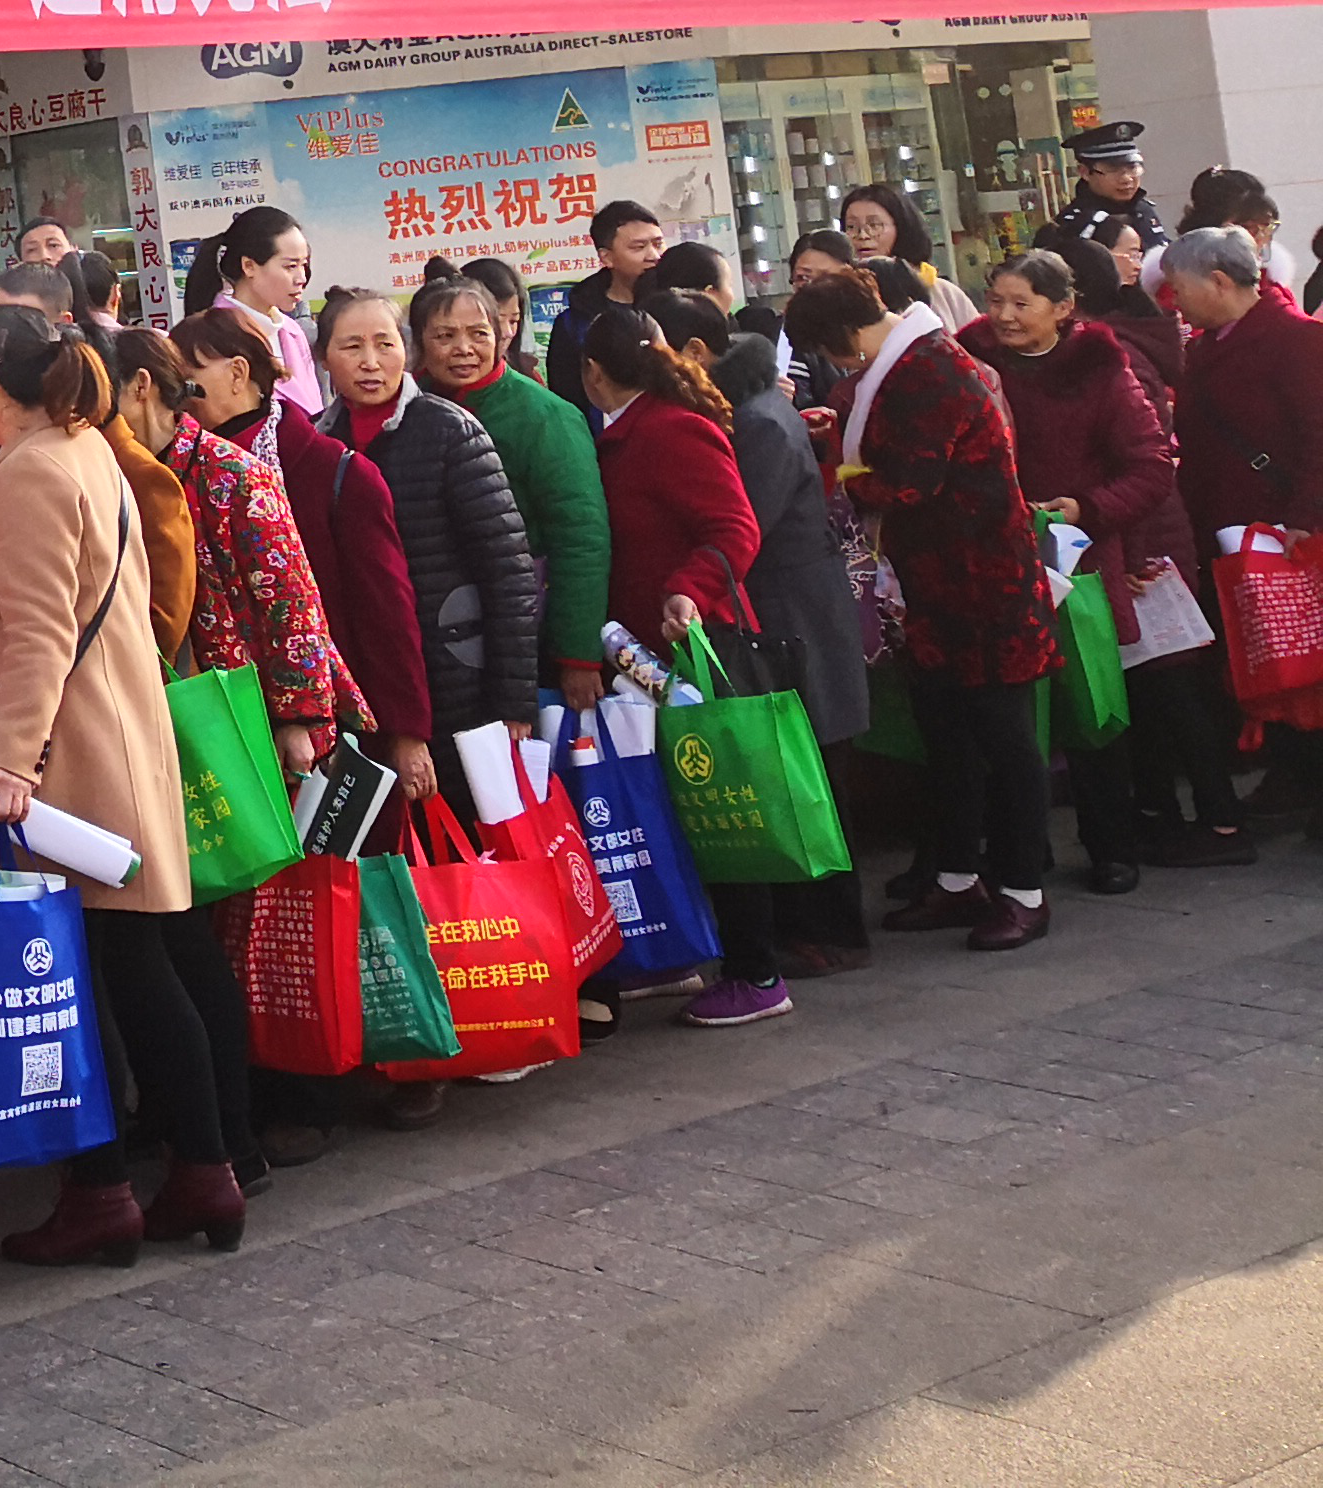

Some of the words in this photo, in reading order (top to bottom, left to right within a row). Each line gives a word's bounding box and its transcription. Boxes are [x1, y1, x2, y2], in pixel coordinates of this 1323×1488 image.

[327, 60, 361, 74] AGM
[364, 56, 407, 71] DAIRY
[409, 51, 461, 66] GROUP
[464, 42, 546, 60] AUSTRALIA
[294, 107, 385, 136] ViPlus
[306, 132, 381, 161] 维爱佳
[378, 141, 598, 179] CONGRATULATIONS
[383, 172, 598, 241] 热烈祝贺
